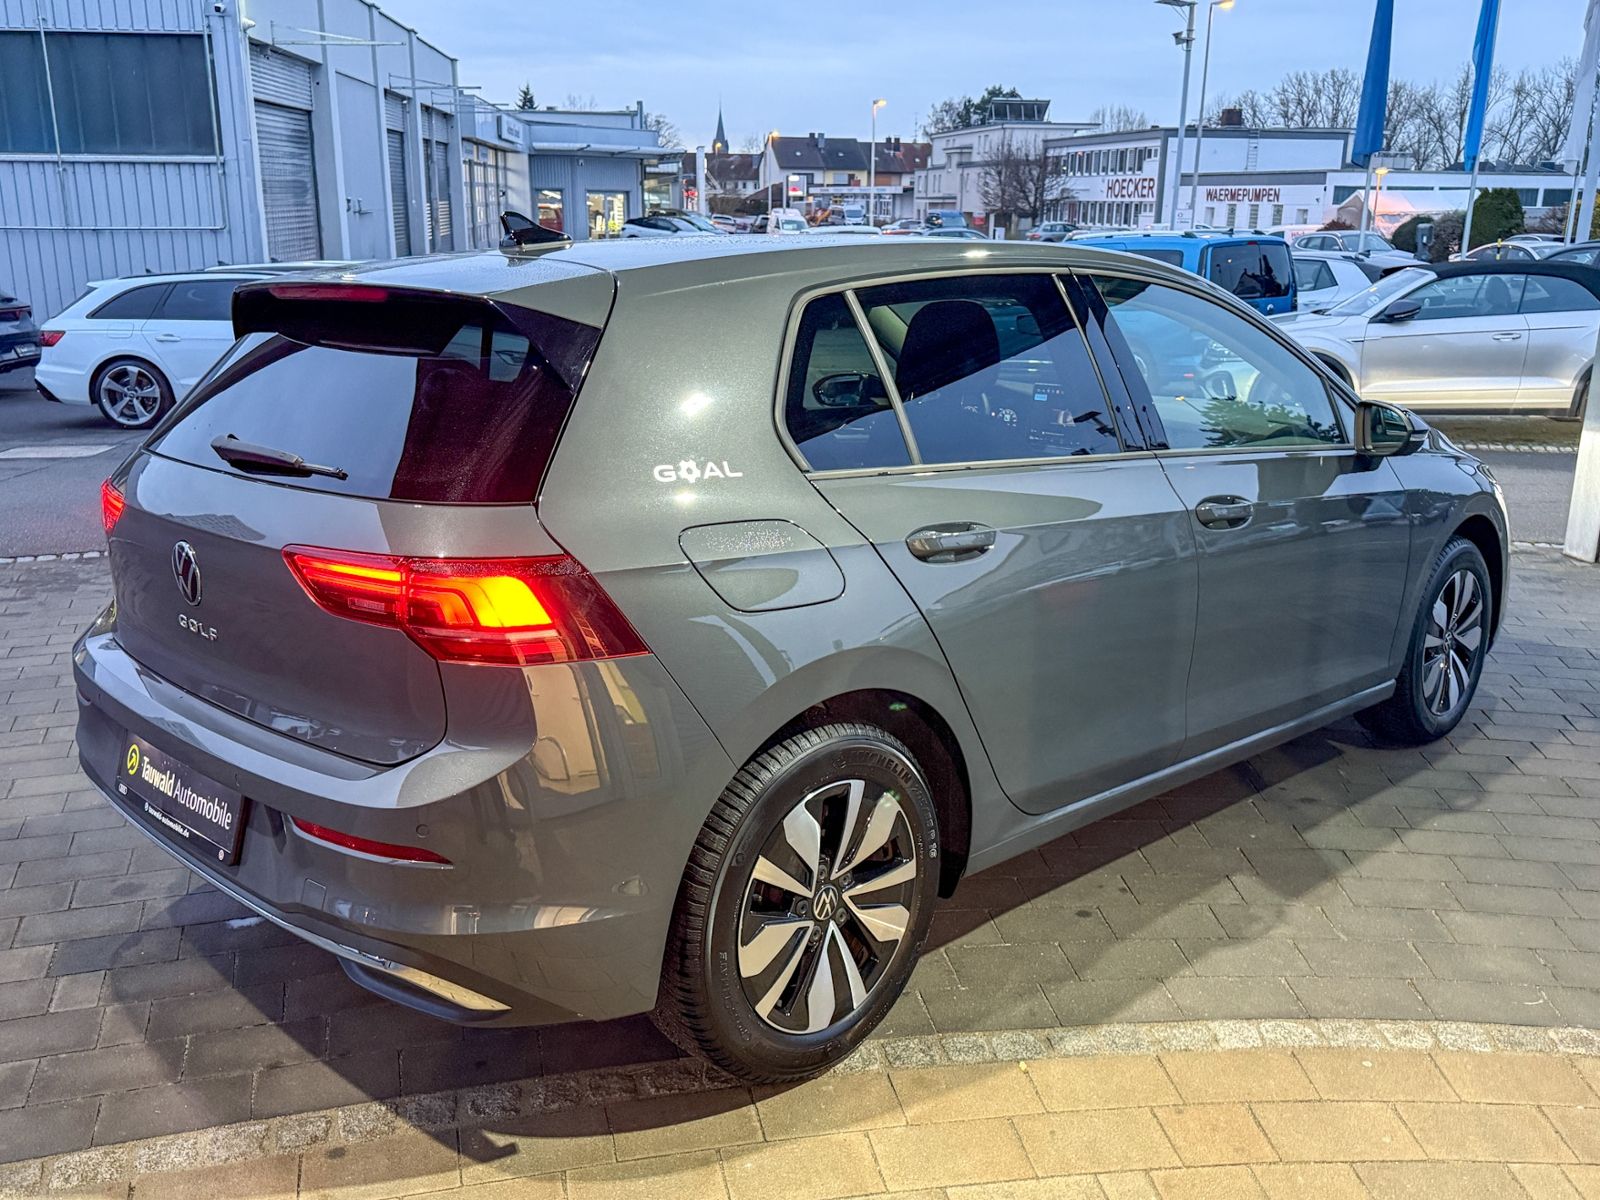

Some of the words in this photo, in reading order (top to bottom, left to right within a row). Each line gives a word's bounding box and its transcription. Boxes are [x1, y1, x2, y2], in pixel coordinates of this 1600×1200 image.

[1106, 177, 1156, 199] HOECKER
[1205, 187, 1281, 202] WAERMEPUMPEN
[653, 459, 744, 483] GOAL
[178, 613, 218, 641] GOLF
[141, 756, 176, 797] Tauwald
[173, 779, 232, 830] Automobile
